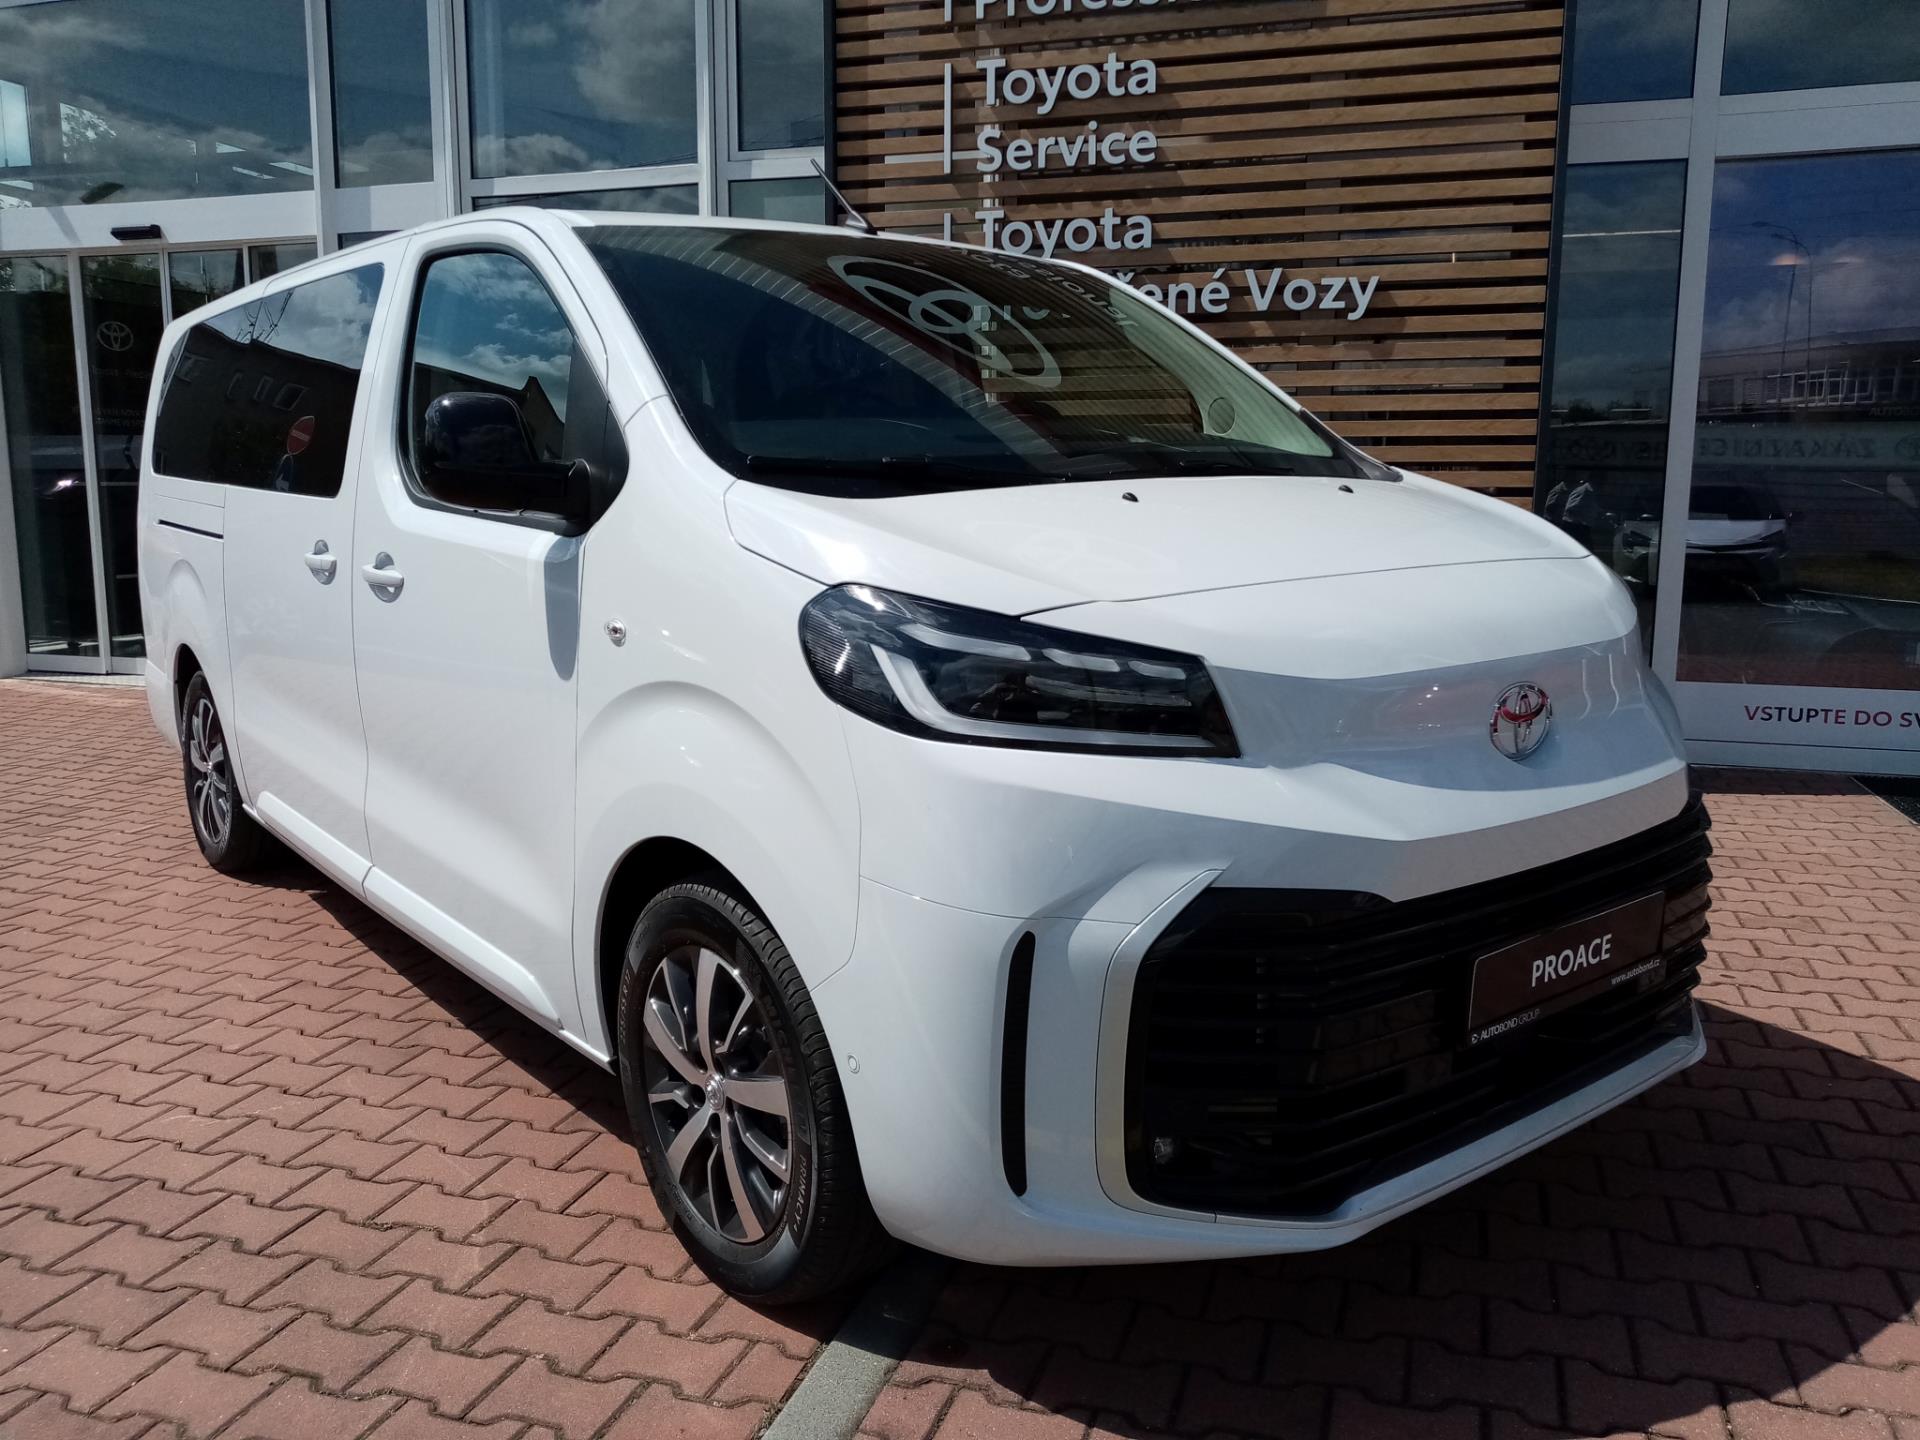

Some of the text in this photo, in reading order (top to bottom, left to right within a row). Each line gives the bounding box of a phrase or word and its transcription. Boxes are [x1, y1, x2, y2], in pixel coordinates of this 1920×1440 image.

[975, 52, 1157, 115] Toyota
[976, 120, 1158, 173] Service
[975, 207, 1153, 258] Toyota
[1245, 267, 1380, 321] Vozy
[1744, 705, 1847, 725] VSTUPTE
[1854, 710, 1893, 727] DO
[1531, 933, 1613, 988] PROACE
[1480, 1017, 1518, 1041] AUTOBOND
[794, 1154, 807, 1225] PRIMACY
